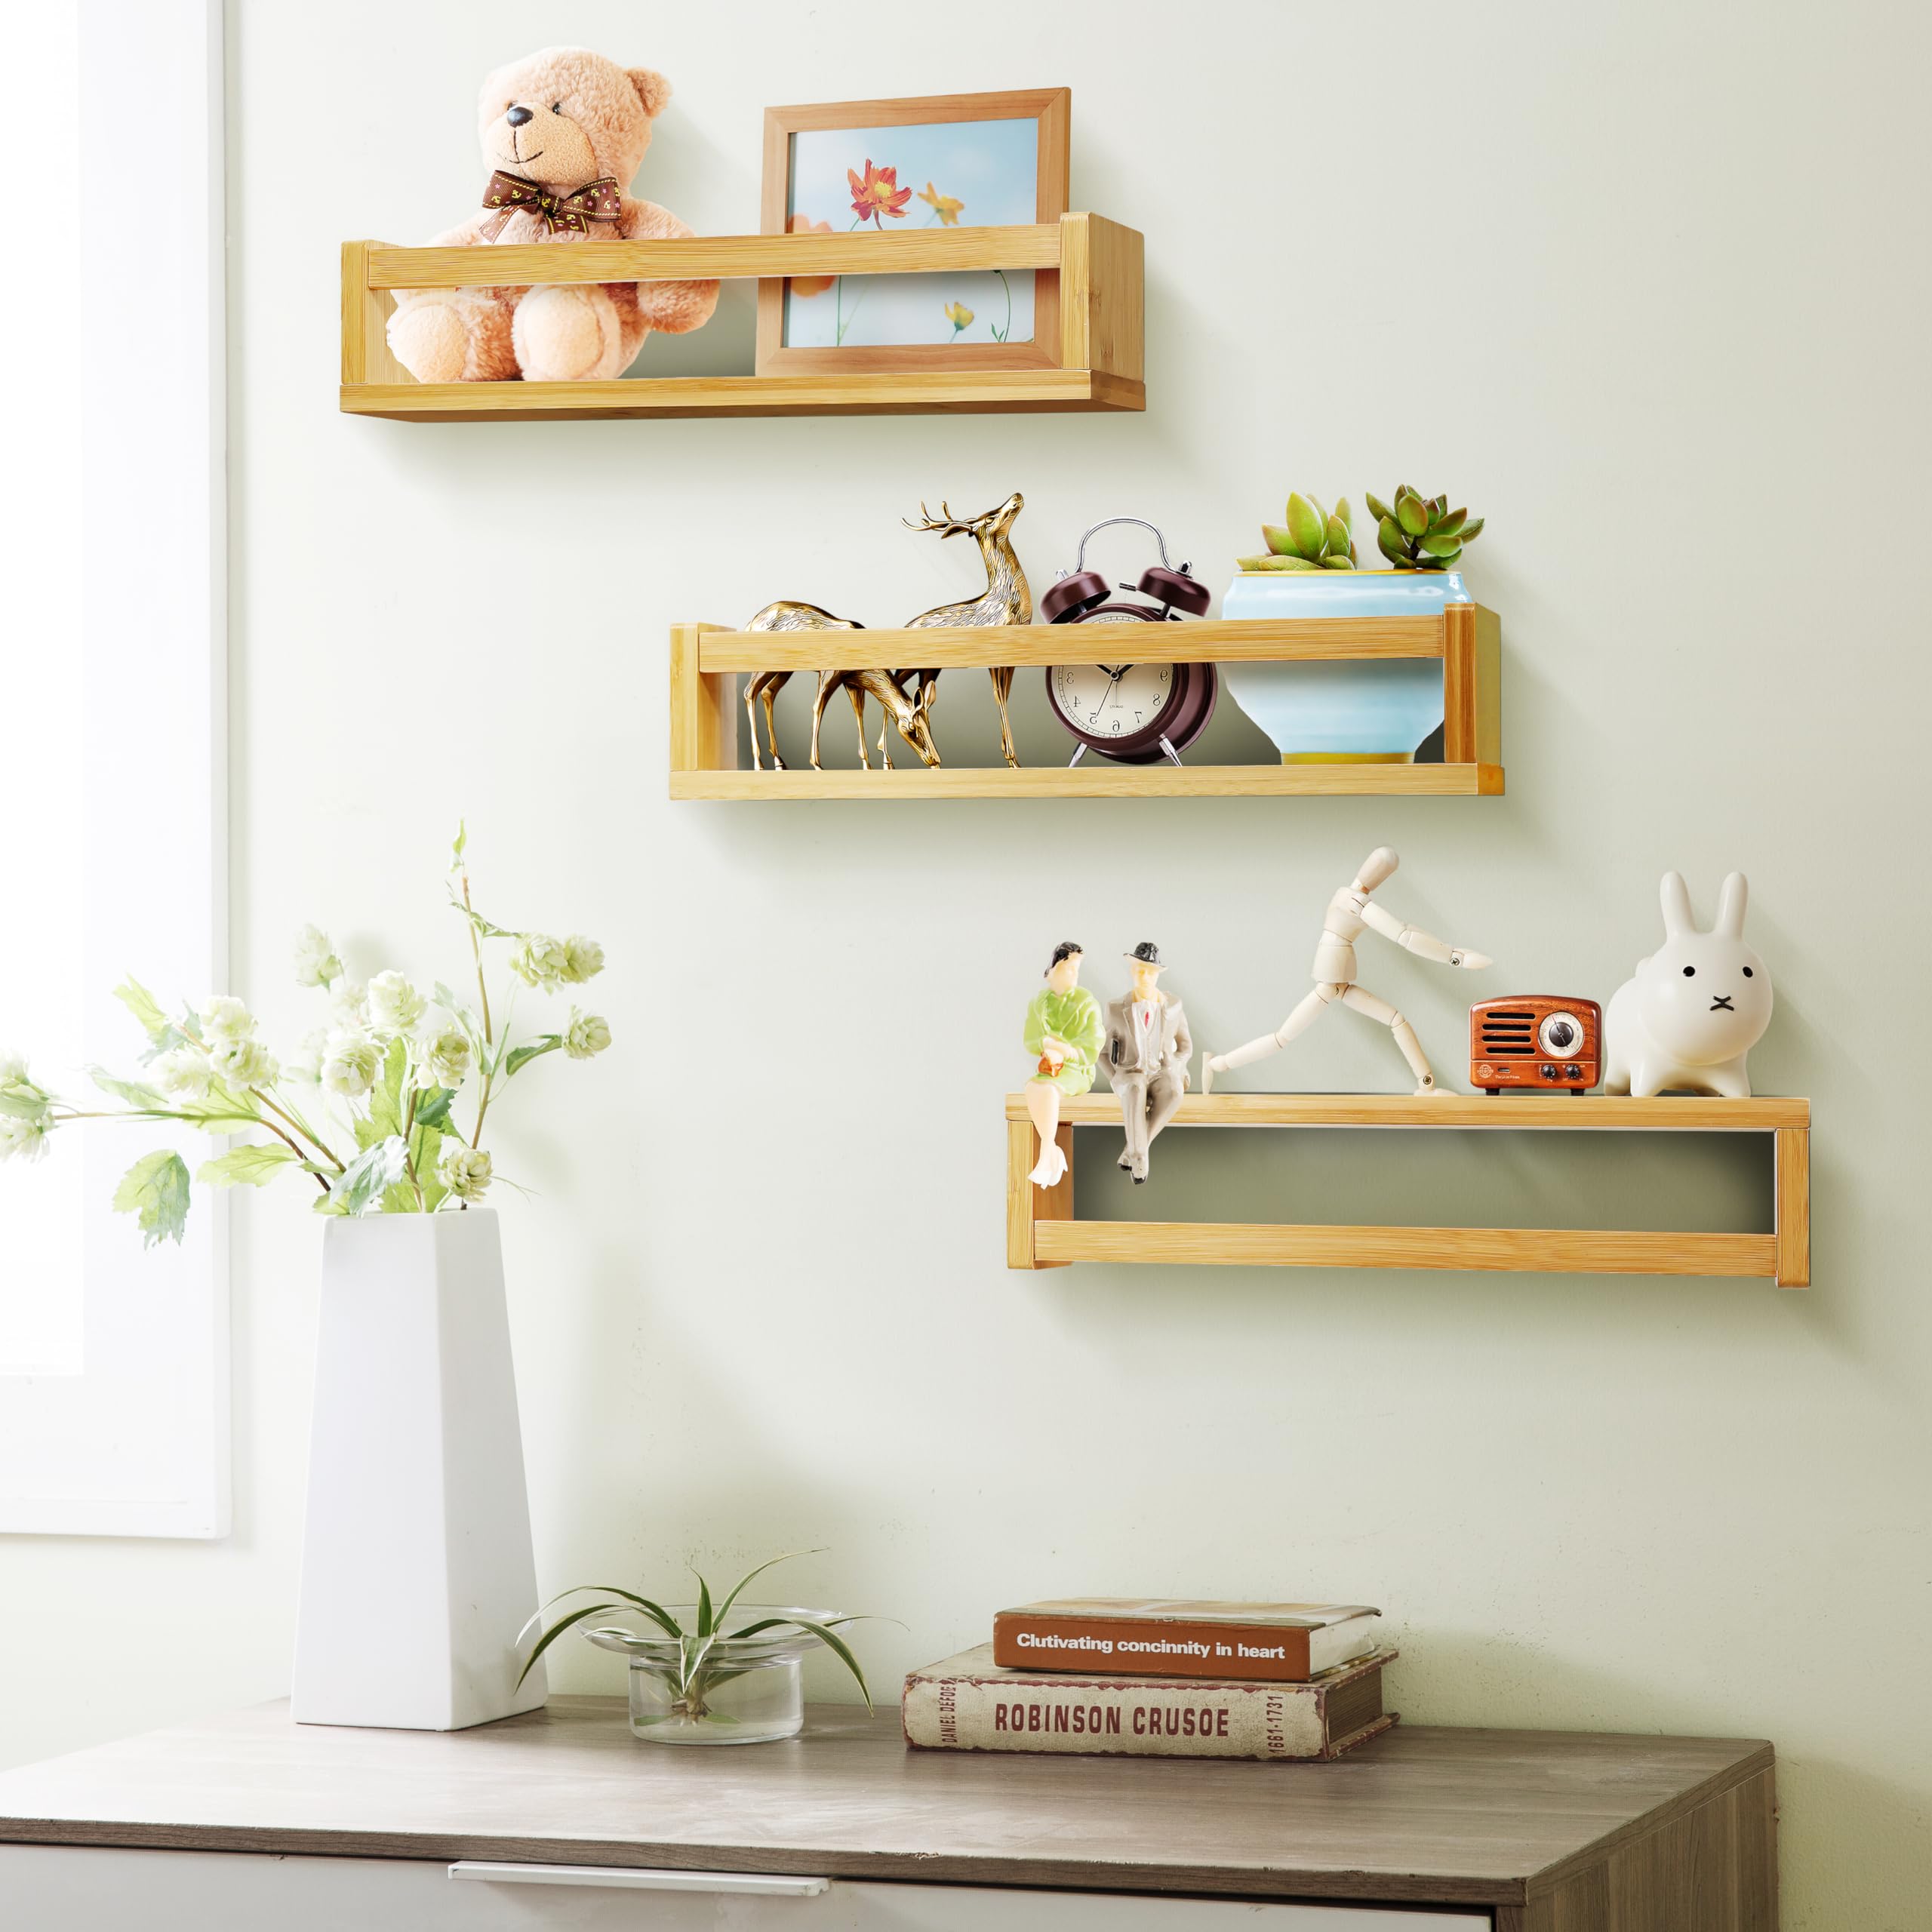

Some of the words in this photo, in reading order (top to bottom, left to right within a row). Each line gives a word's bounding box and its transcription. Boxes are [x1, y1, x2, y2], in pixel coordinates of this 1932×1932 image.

[1017, 1633, 1113, 1654] Clutivating
[1117, 1639, 1211, 1659] concinnity
[1216, 1642, 1232, 1657] in
[1238, 1643, 1285, 1659] heart
[939, 1687, 956, 1712] DEFOE
[940, 1716, 958, 1743] DANIEL
[995, 1703, 1121, 1734] ROBINSON
[1133, 1706, 1229, 1737] CRUSOE
